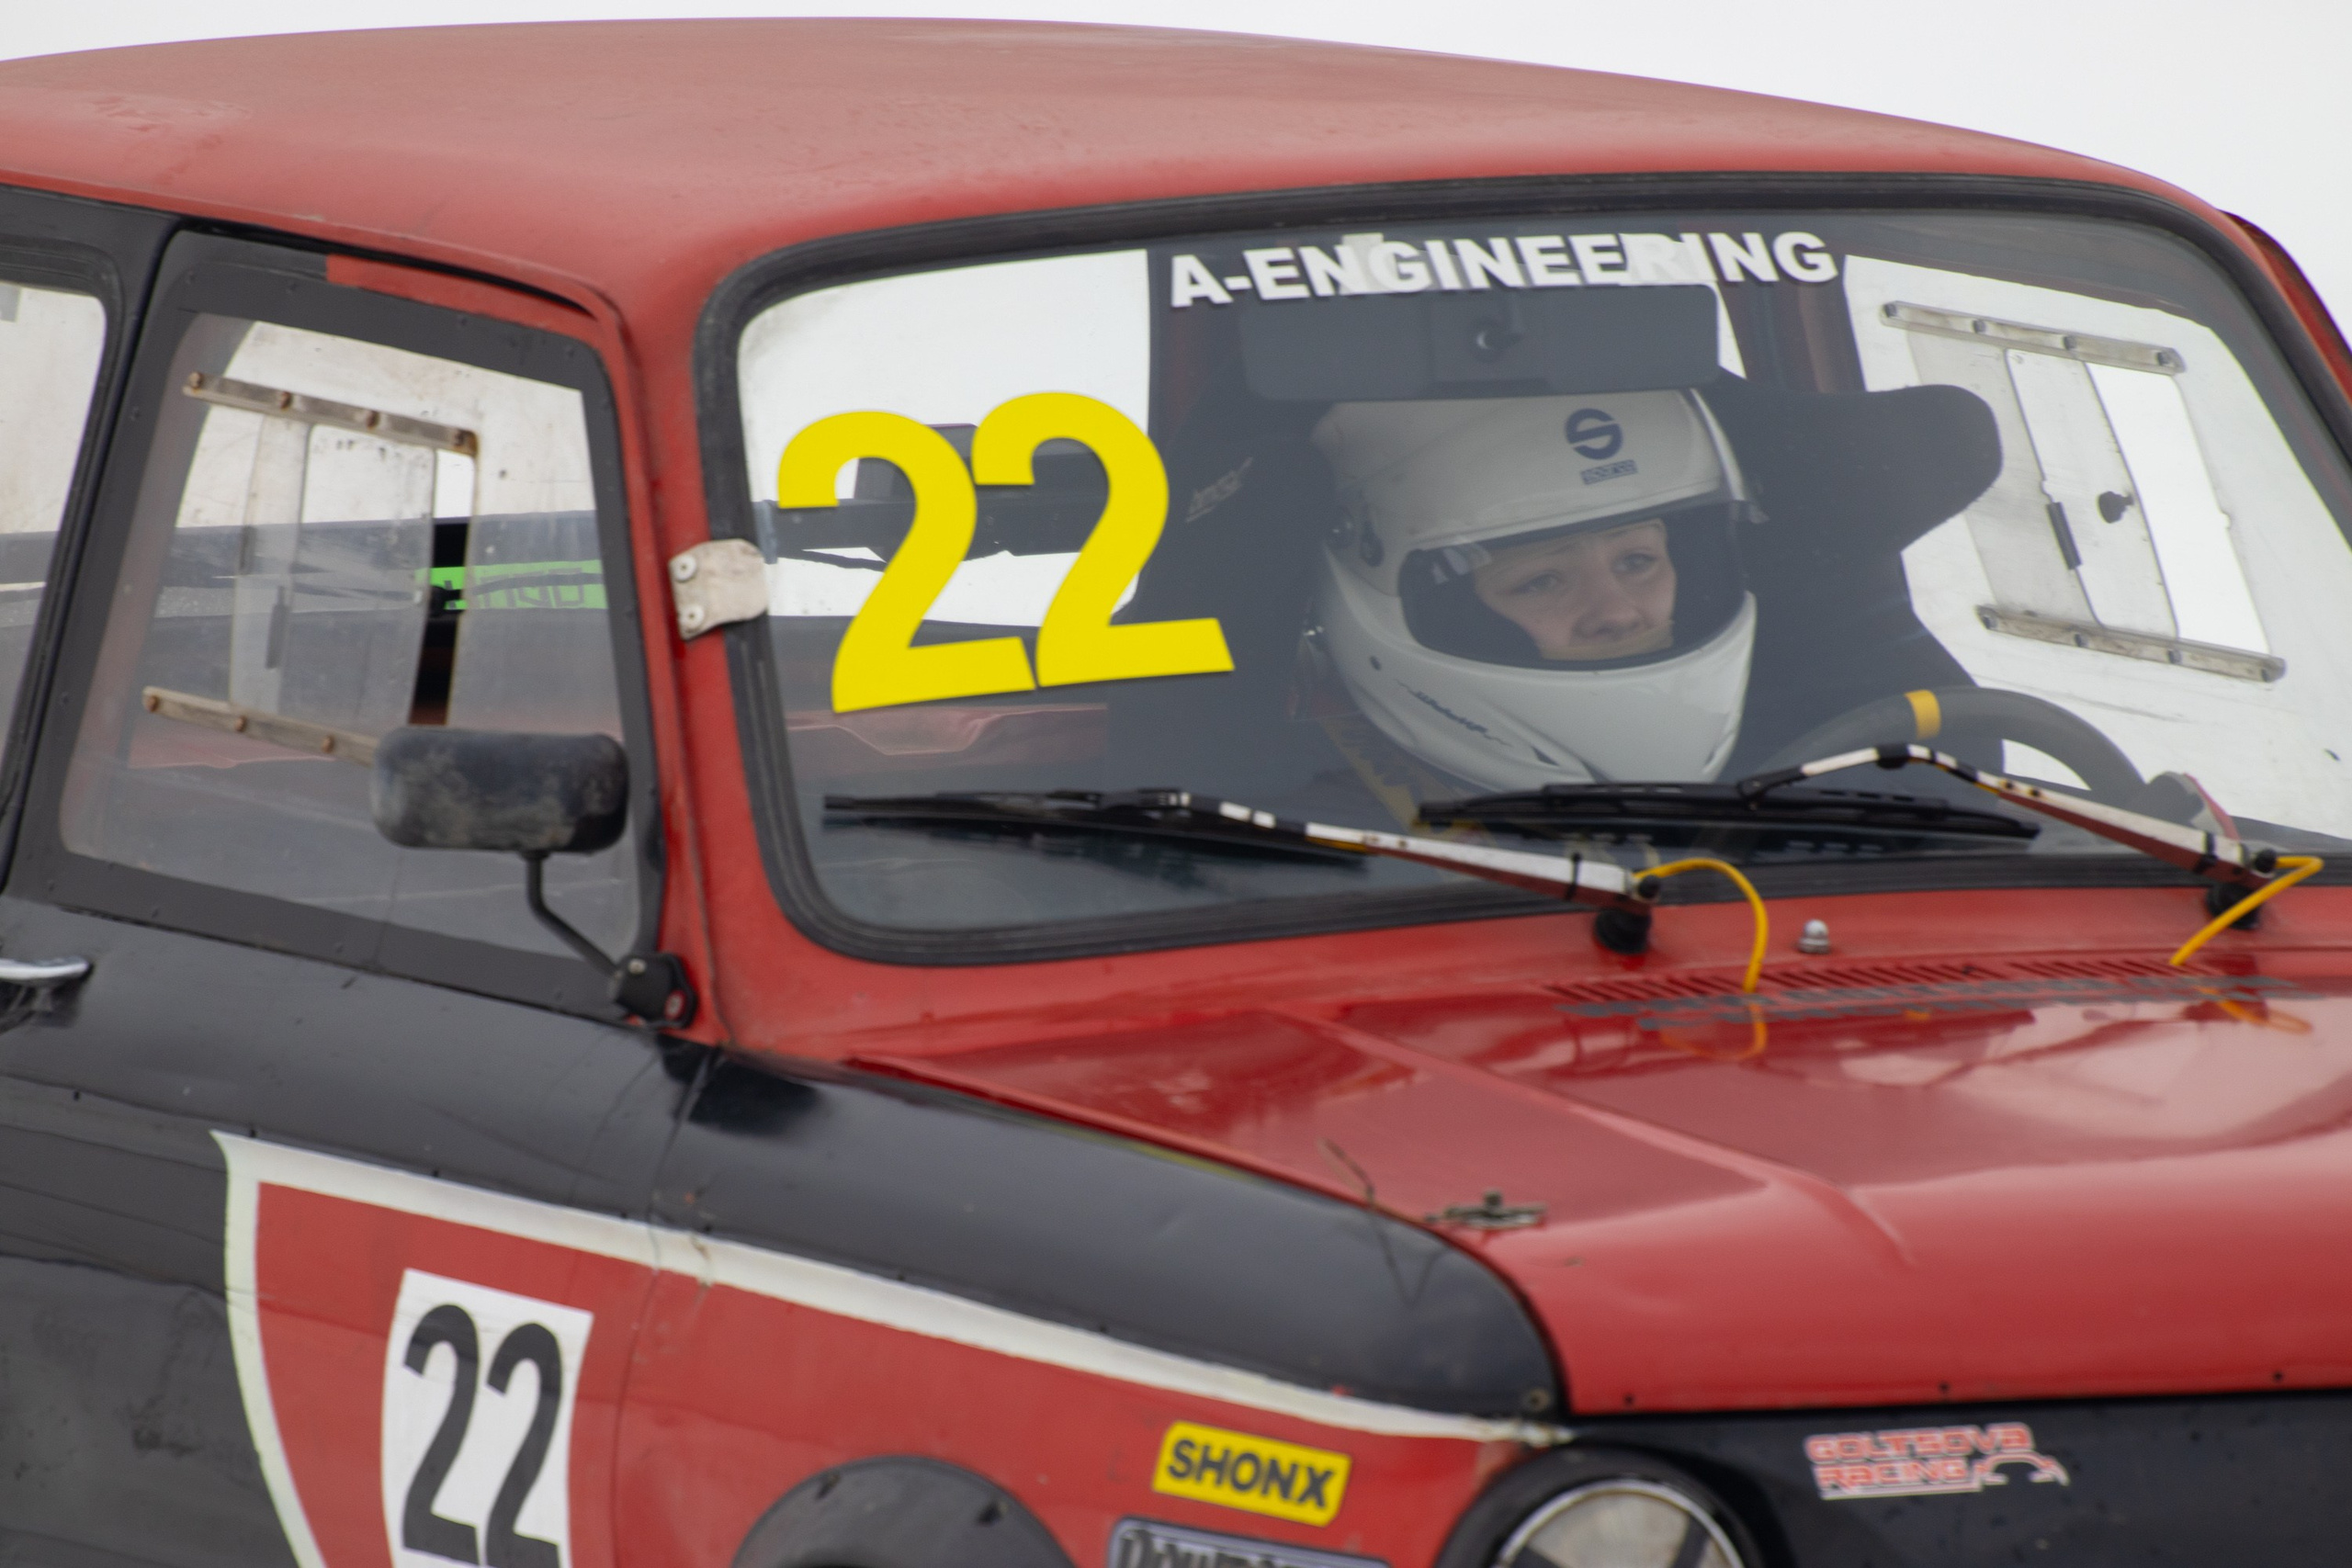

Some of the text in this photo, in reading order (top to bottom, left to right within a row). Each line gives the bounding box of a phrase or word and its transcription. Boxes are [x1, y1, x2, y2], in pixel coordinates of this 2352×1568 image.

[1170, 231, 1838, 308] A-ENGINEERING
[776, 390, 1236, 714] 22
[402, 1303, 563, 1568] 22
[1167, 1438, 1335, 1509] SHONX
[1814, 1458, 1969, 1495] RACING
